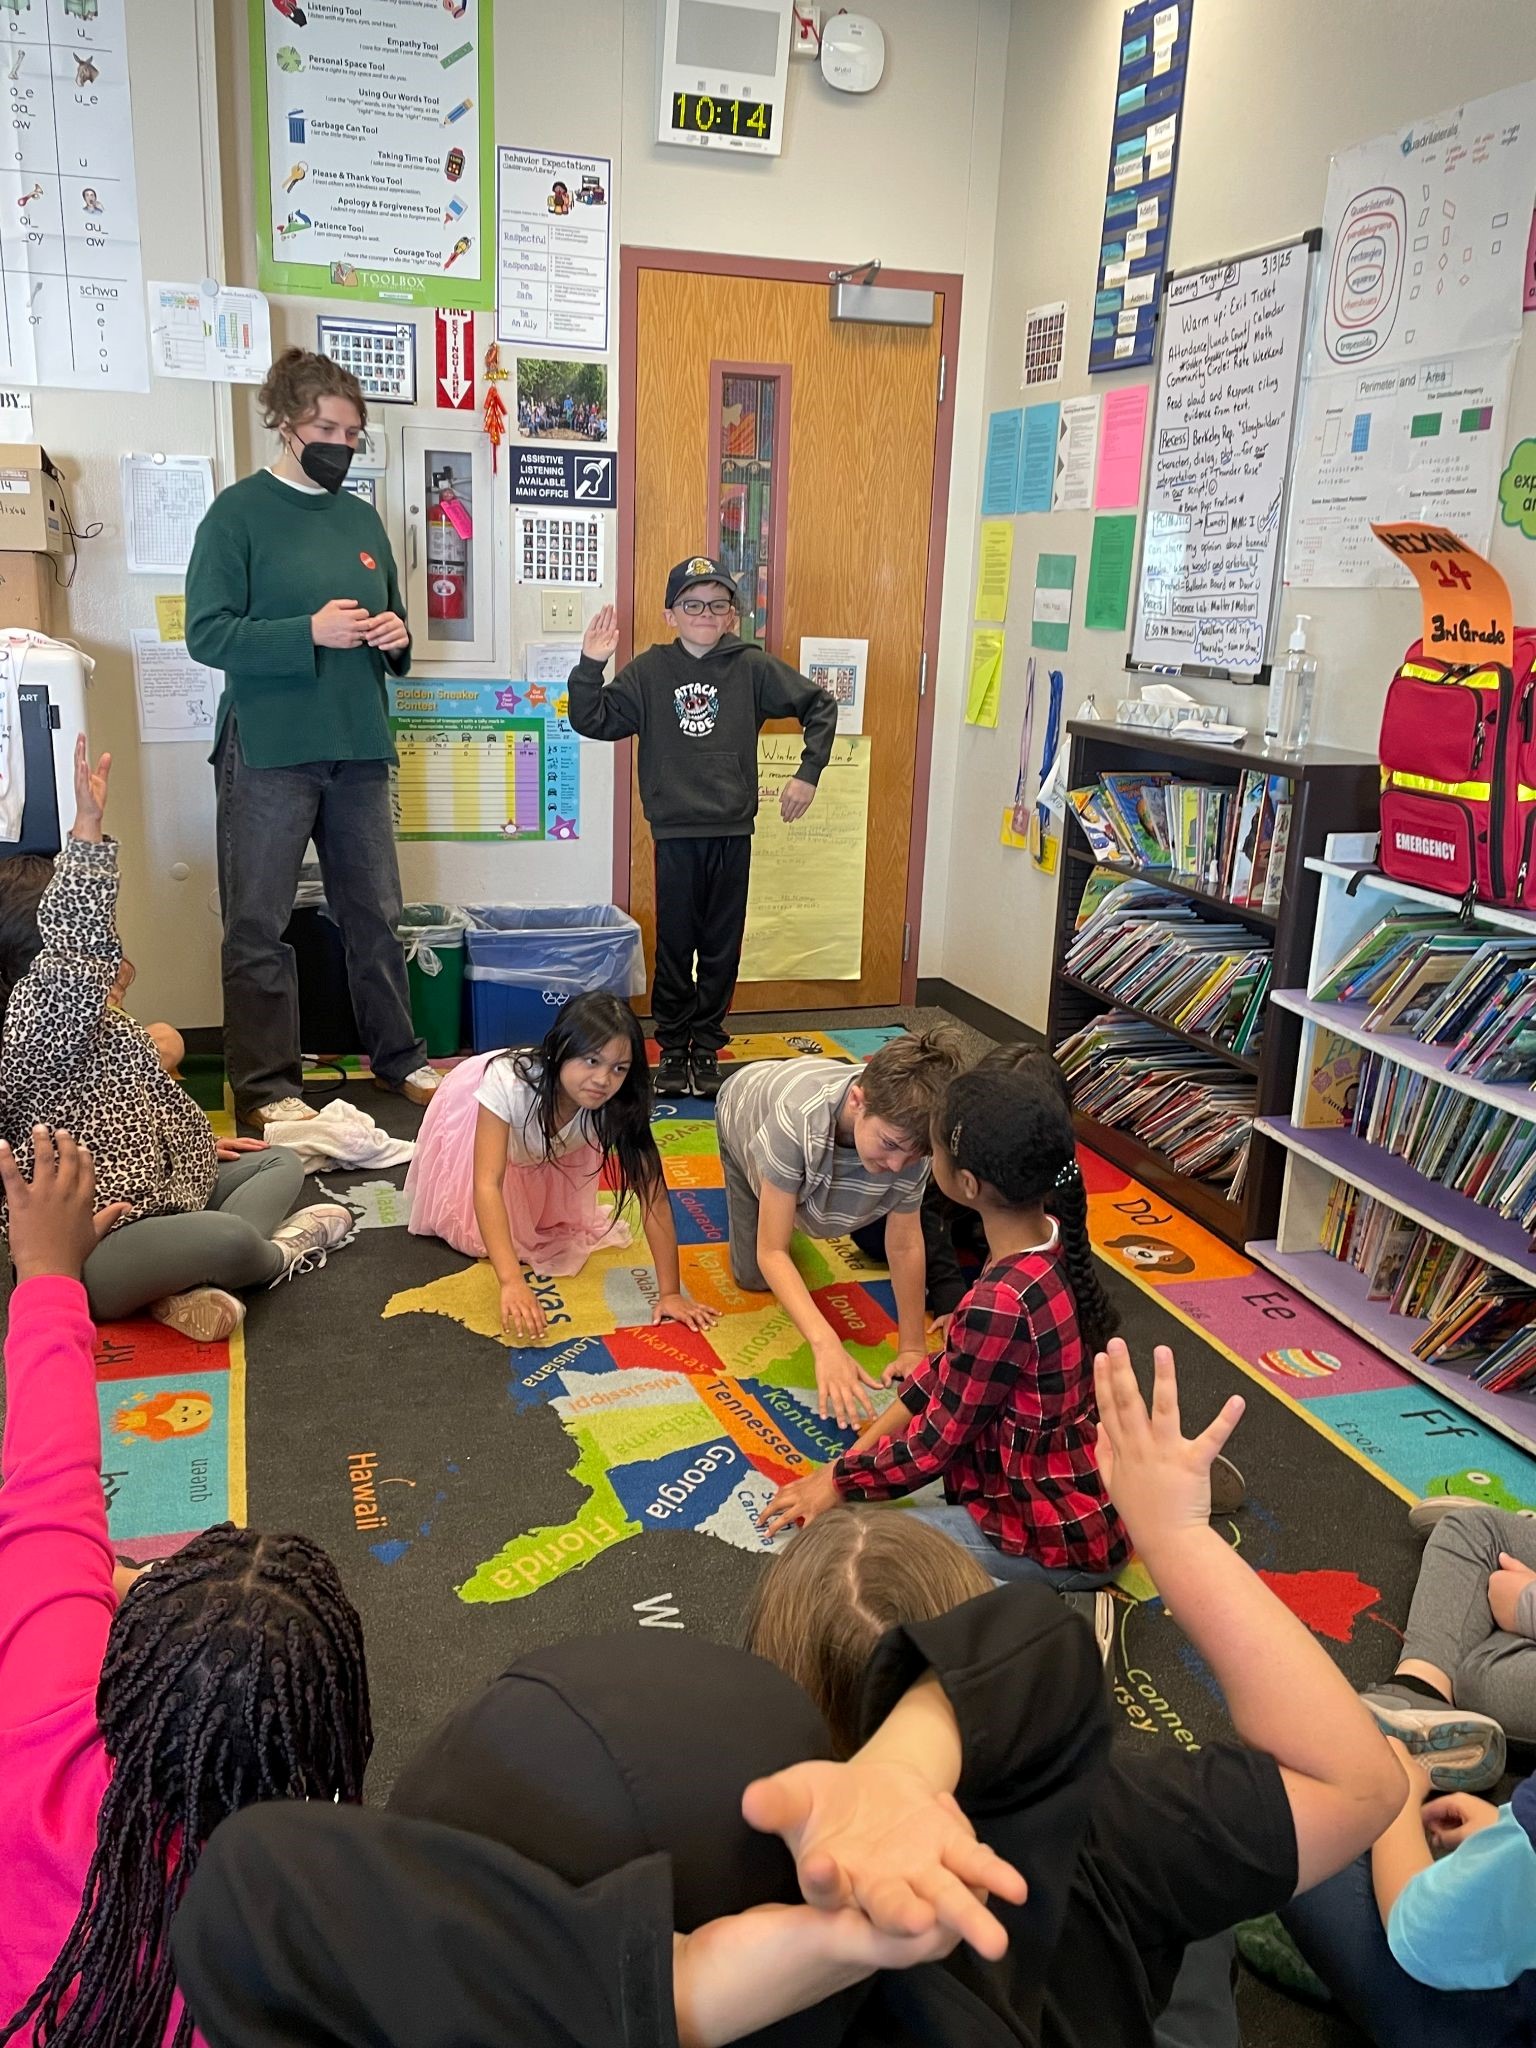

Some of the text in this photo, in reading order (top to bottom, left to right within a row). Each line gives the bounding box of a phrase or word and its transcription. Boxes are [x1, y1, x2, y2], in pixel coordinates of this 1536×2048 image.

[307, 2, 362, 16] Listening Tool
[388, 37, 439, 51] Empathy Tool
[309, 55, 385, 71] Personal Space Tool
[359, 88, 440, 105] Using Our Words Tool
[311, 120, 378, 134] Garbage Can Tool
[677, 93, 767, 137] 10:14
[378, 151, 441, 165] Taking Time Tool
[504, 153, 596, 172] Behavior Expectations
[313, 169, 403, 185] Please & Thank You Tool
[338, 197, 441, 215] Apology & Forgiveness Tool
[314, 221, 364, 233] Patience Tool
[393, 247, 442, 259] Courage Tool
[1262, 250, 1292, 276] 3/3/25
[80, 284, 118, 298] schwa
[360, 272, 425, 288] TOOLBOX
[1170, 281, 1198, 299] Learning
[1182, 314, 1209, 334] Warm
[1230, 293, 1247, 316] Exit
[1251, 280, 1276, 304] Ticket
[451, 319, 460, 400] EXTINGUISHER
[1167, 365, 1206, 389] Community
[1253, 337, 1284, 364] Weekend
[1360, 371, 1446, 394] Perimeter and Area
[1162, 430, 1187, 450] Recess
[520, 454, 564, 465] ASSISTIVE
[520, 465, 564, 476] LISTENING
[1, 480, 12, 491] 14
[515, 488, 569, 498] MAIN OFFICE
[518, 477, 566, 487] AVAILABLE
[1430, 559, 1471, 590] 14
[1431, 614, 1506, 645] 3rd Grade
[20, 693, 38, 701] ART
[395, 688, 479, 700] Golden Sneaker
[395, 700, 437, 712] Contest
[674, 682, 718, 700] ATTACK
[680, 717, 715, 733] MODE
[761, 739, 797, 761] Winter
[1396, 831, 1456, 861] EMERGENCY
[663, 1156, 696, 1188] Utah
[676, 1190, 723, 1241] Colorado
[1113, 1197, 1174, 1227] Dd
[822, 1236, 866, 1273] akota
[520, 1260, 572, 1325] exas
[695, 1250, 746, 1306] Kansas
[826, 1293, 867, 1331] Iowa
[1242, 1290, 1297, 1321] Ee
[522, 1336, 601, 1389] Louisiana
[627, 1325, 707, 1373] Arkansas
[567, 1374, 682, 1413] Mississippi
[610, 1405, 716, 1457] Alabama
[706, 1379, 803, 1467] Tennessee
[762, 1390, 844, 1461] Kentuck
[1335, 1420, 1385, 1455] frog
[1400, 1408, 1480, 1439] Ff
[189, 1456, 209, 1504] queen
[347, 1451, 390, 1532] Hawaii
[645, 1444, 736, 1520] Georgia
[489, 1516, 622, 1591] Florida
[632, 1591, 686, 1630] W
[1112, 1675, 1160, 1734] rsey
